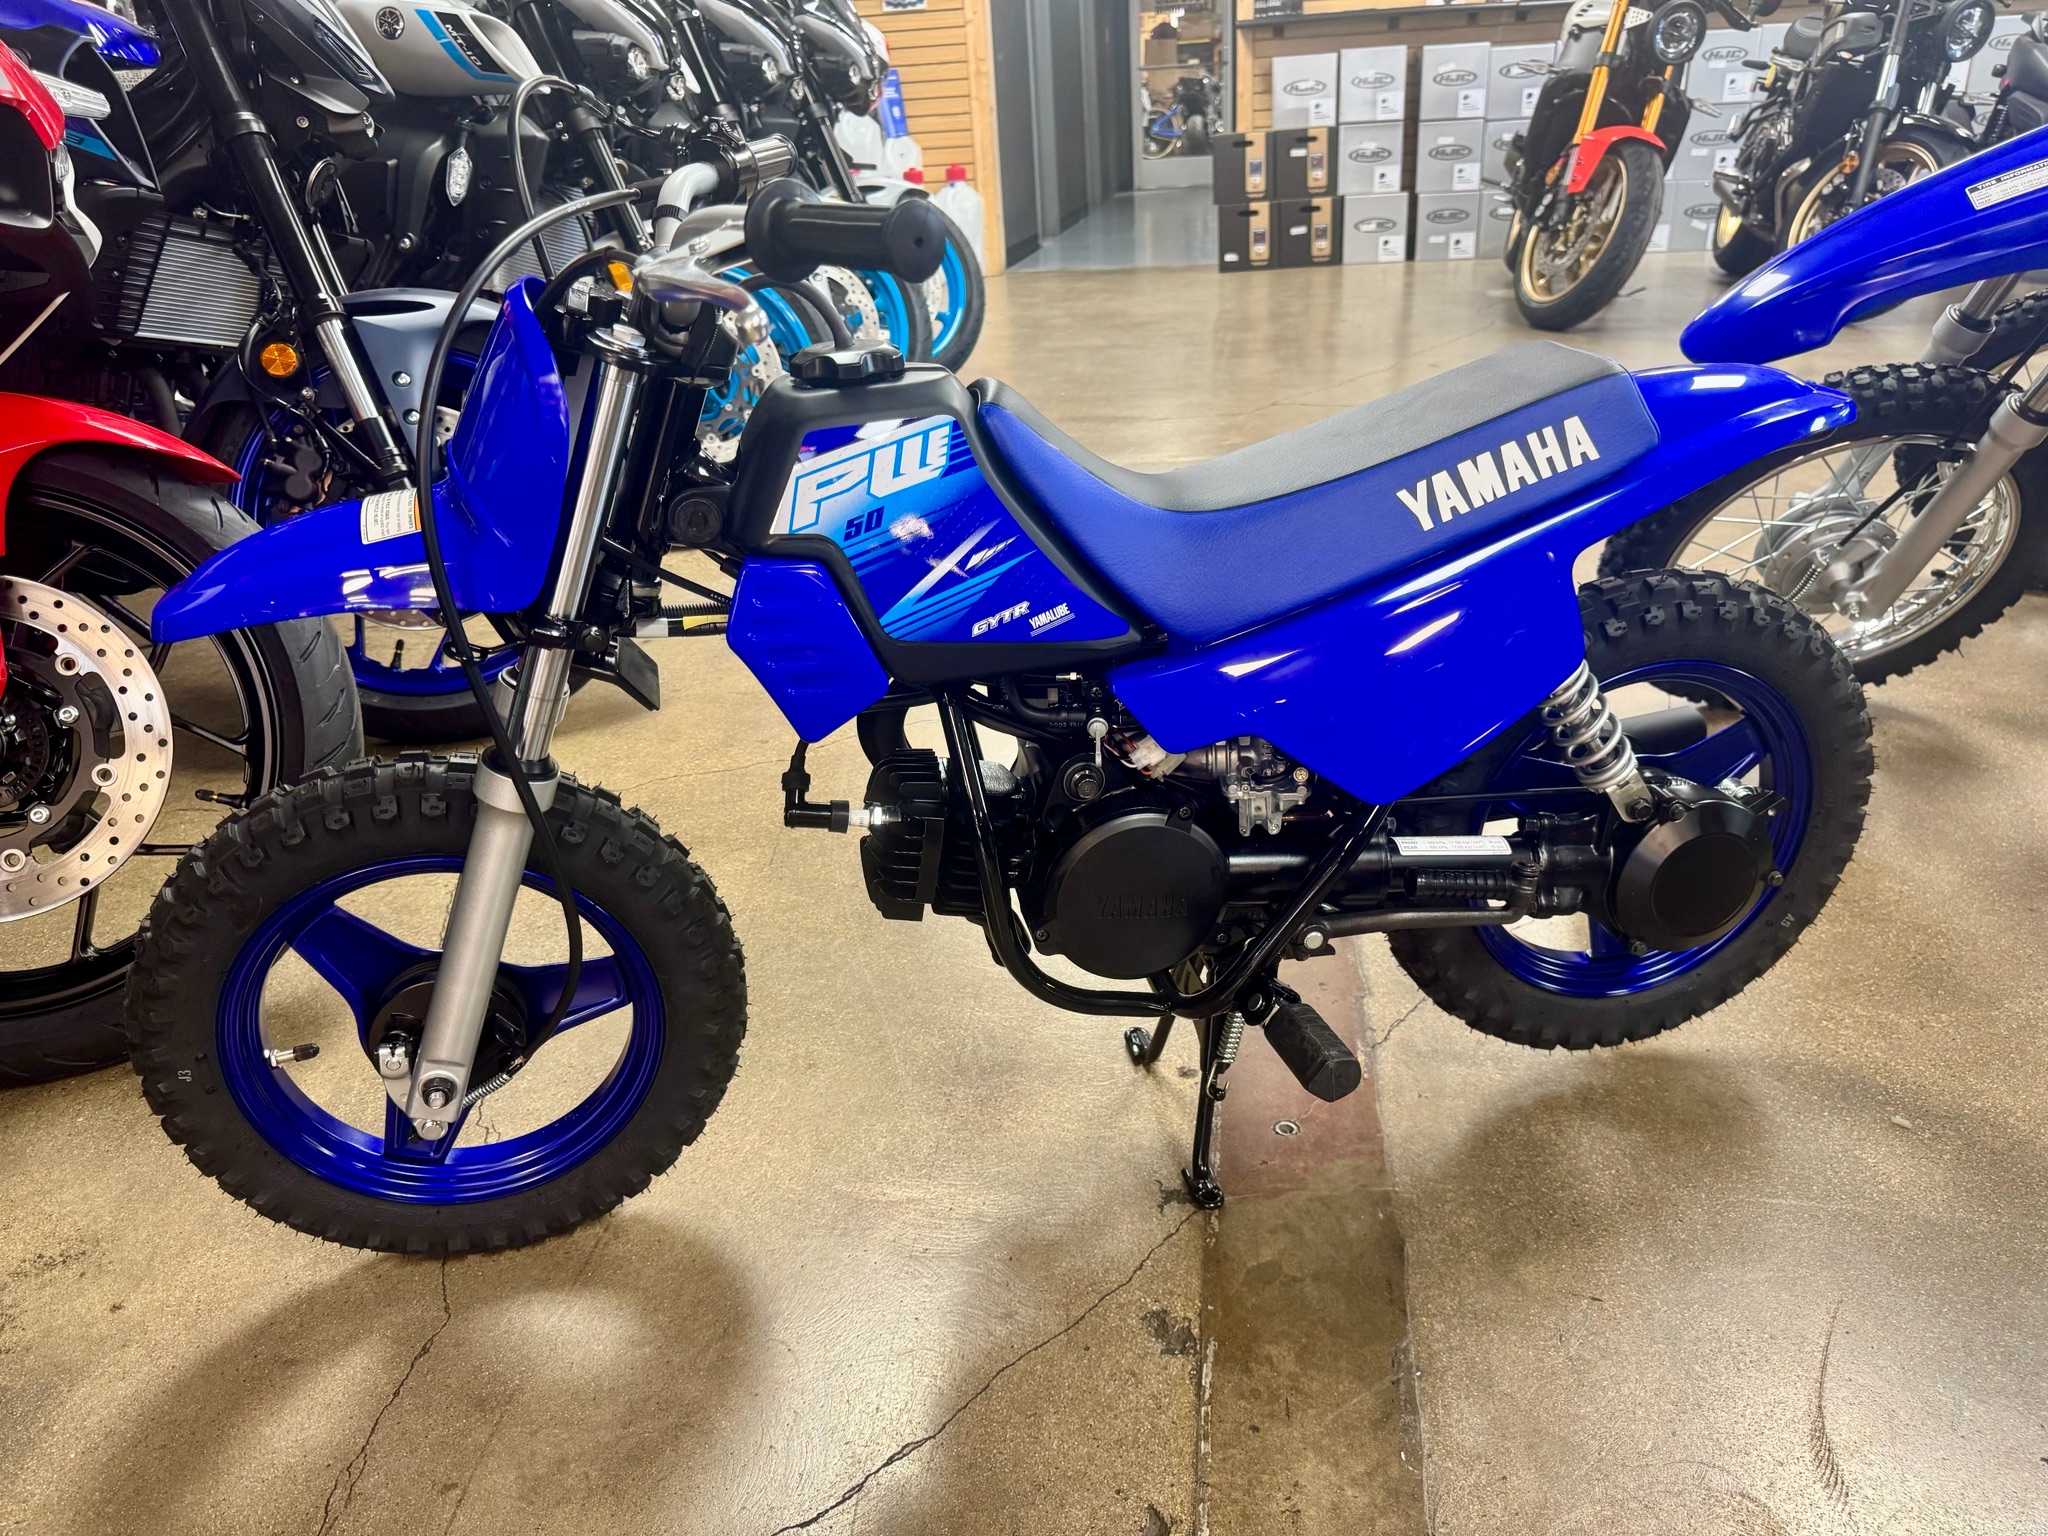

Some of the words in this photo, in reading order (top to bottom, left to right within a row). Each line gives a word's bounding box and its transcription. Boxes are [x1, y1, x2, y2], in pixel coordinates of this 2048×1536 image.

[445, 24, 482, 66] MT-10
[2001, 161, 2048, 182] INFORMATI
[1396, 416, 1600, 532] YAMAHA
[843, 506, 884, 542] 50
[972, 601, 1030, 637] GYTR
[1029, 603, 1070, 629] YAMALUBE
[1098, 895, 1189, 918] YAMAHA
